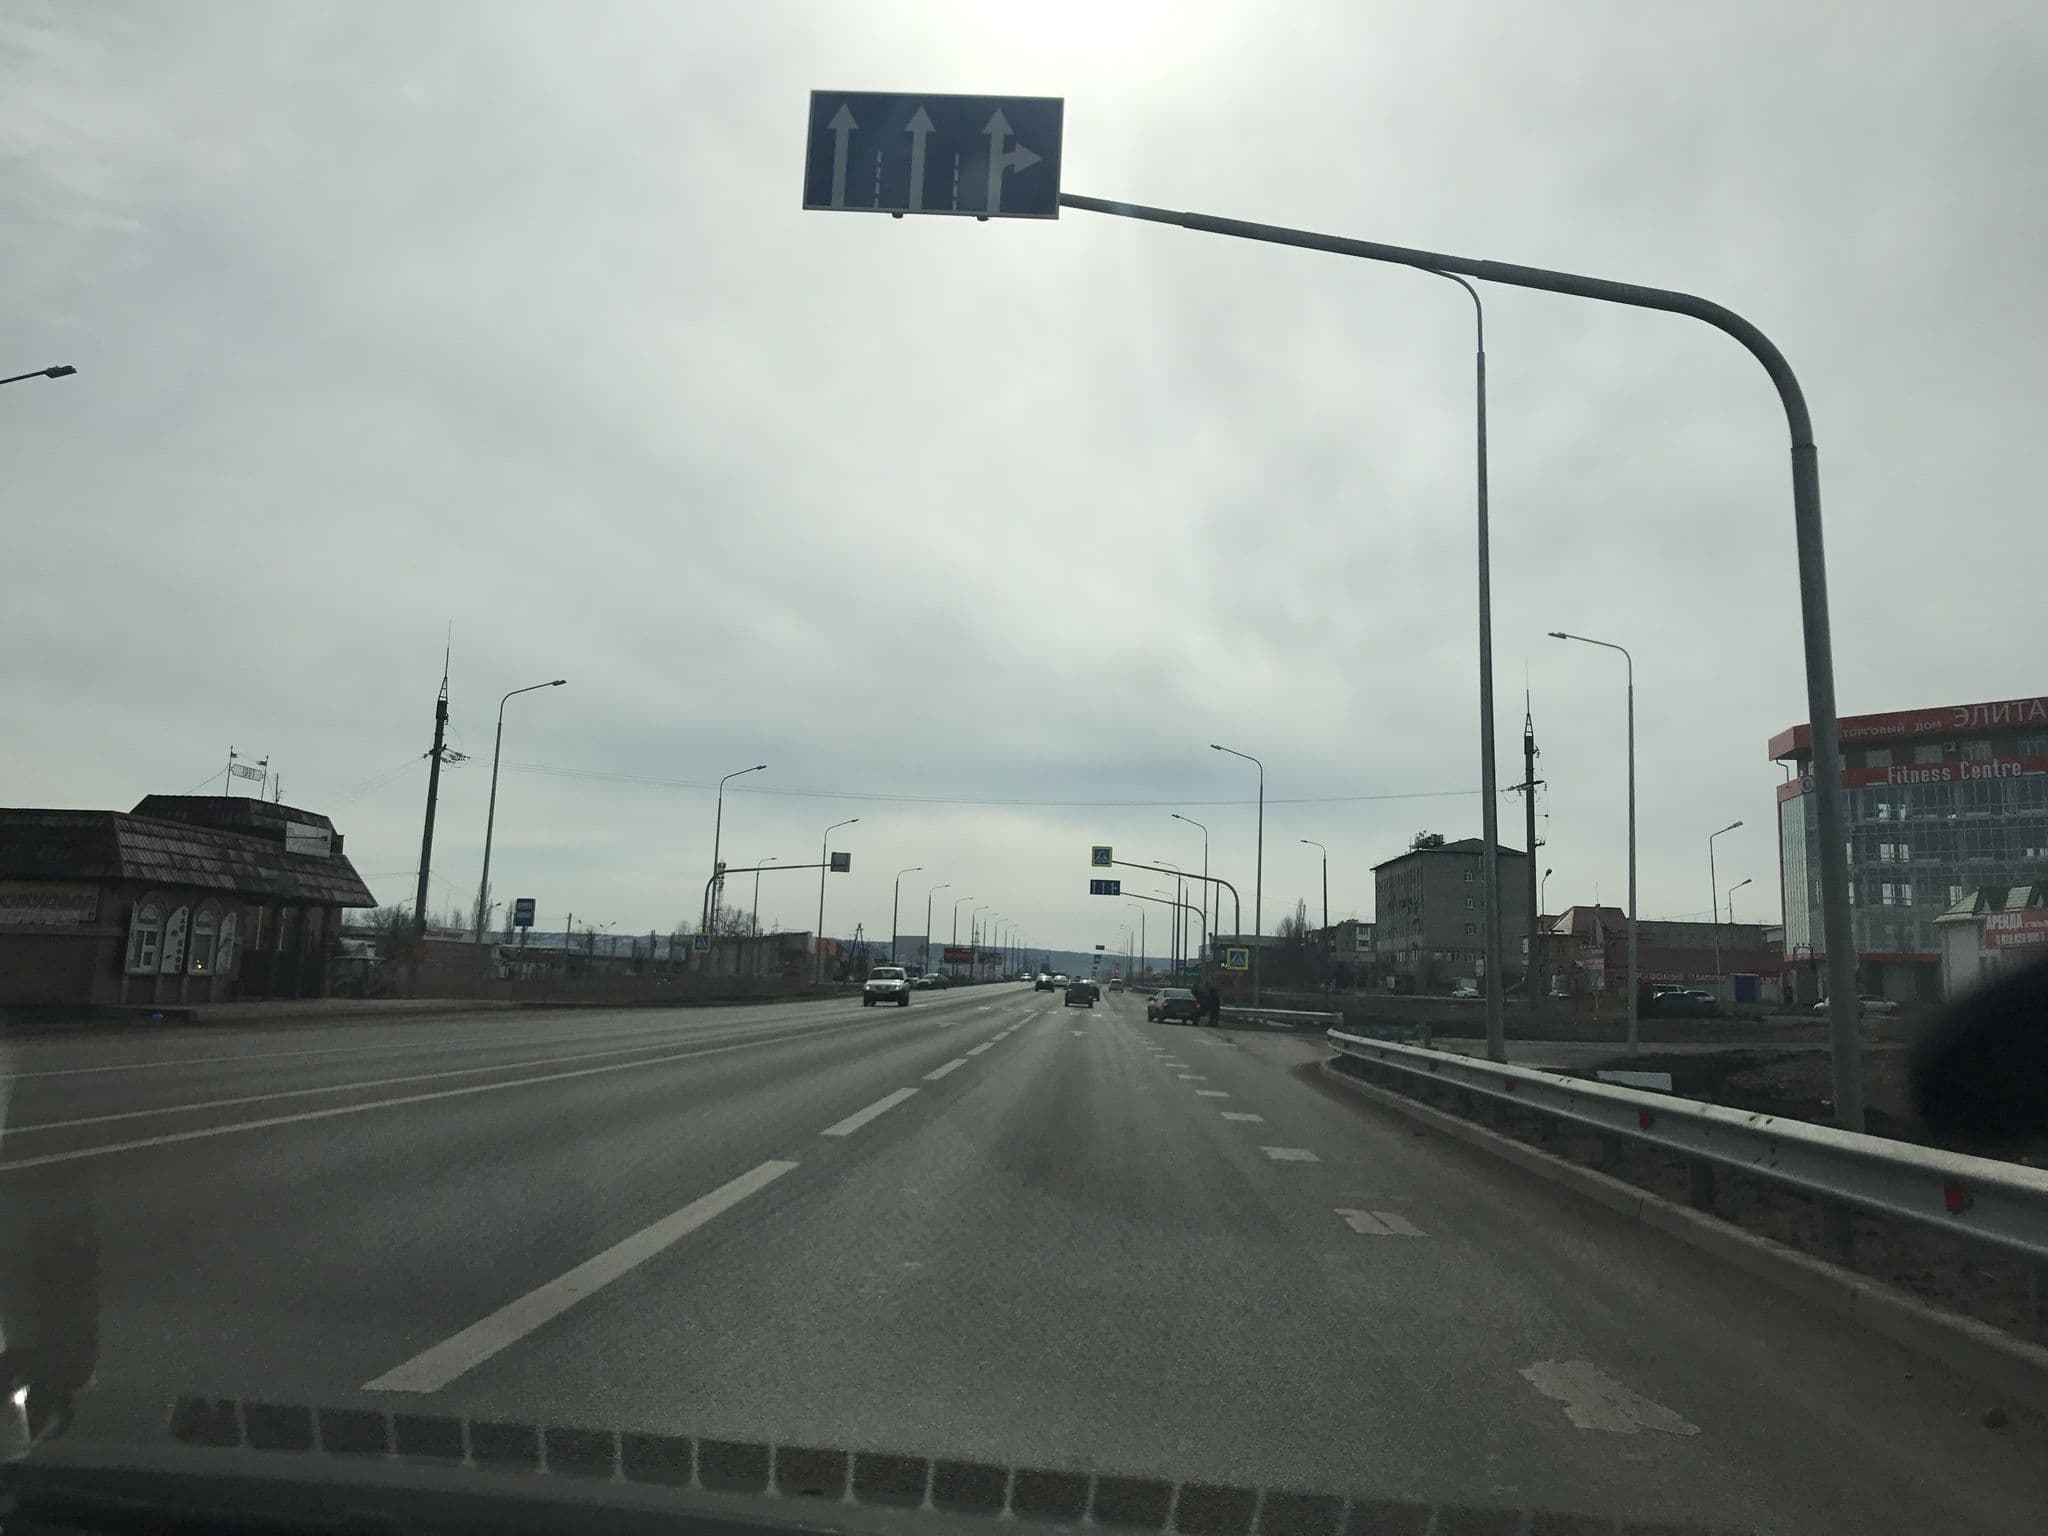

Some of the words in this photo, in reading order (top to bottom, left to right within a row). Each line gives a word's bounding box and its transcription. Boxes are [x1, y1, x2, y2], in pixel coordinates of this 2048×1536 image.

[1843, 722, 1905, 737] ТОРГОВЫЙ
[1914, 720, 1942, 732] ДОМ
[1952, 699, 2046, 727] ЭЛИТА
[1887, 765, 1951, 785] Fitness
[1960, 758, 2022, 780] Centre
